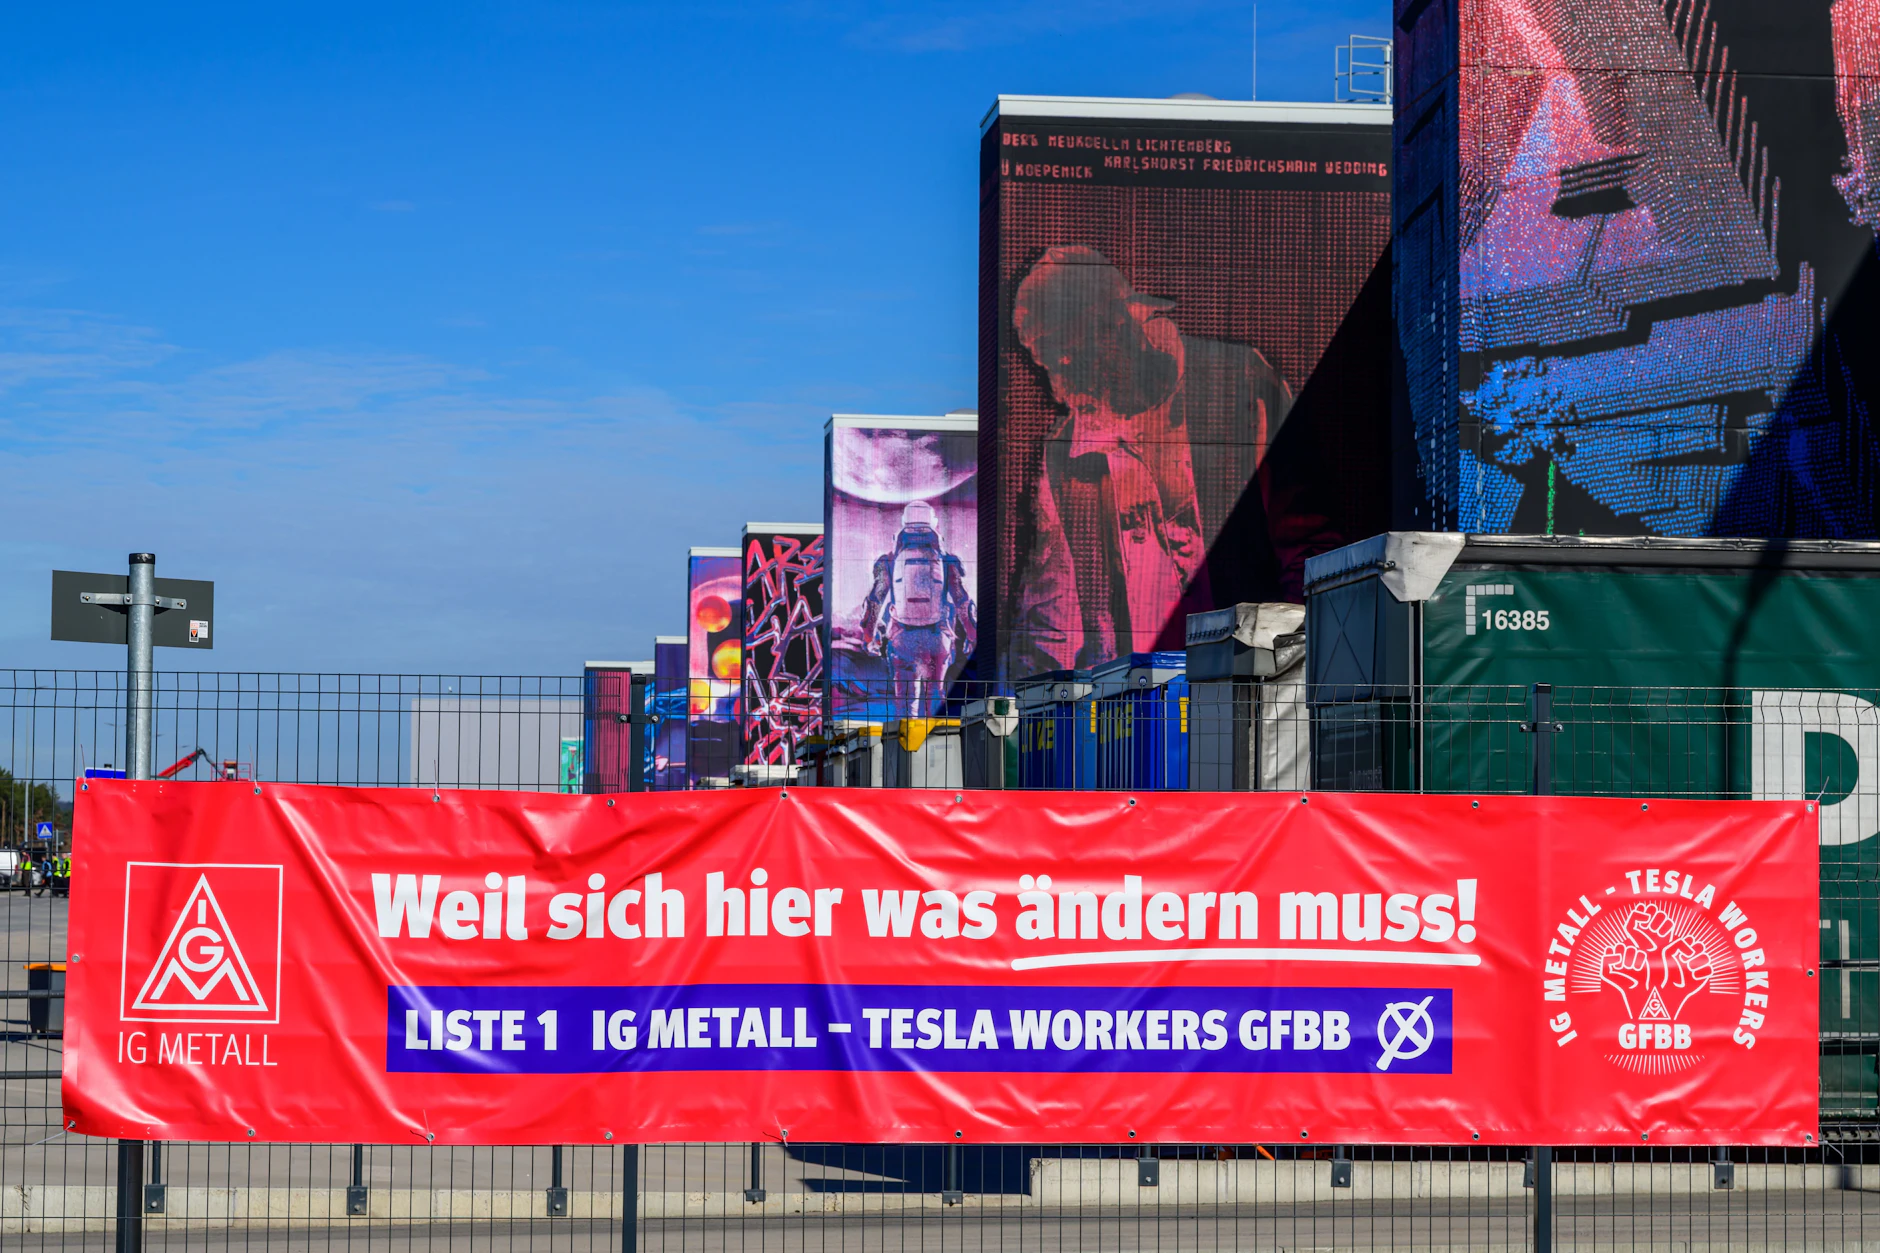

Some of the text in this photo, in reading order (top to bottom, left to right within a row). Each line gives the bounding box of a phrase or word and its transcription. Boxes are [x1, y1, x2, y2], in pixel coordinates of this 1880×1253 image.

[1136, 139, 1232, 154] LICHTENBERG
[1104, 156, 1195, 173] KARLSHORST
[1203, 158, 1317, 174] FRIEDRICHSHAIN
[1325, 161, 1387, 177] WEDDING
[1482, 609, 1550, 631] 16385
[371, 867, 1478, 944] Weil sich hier was ändern muss!
[1625, 868, 1716, 909] TESLA
[1544, 894, 1602, 1002] METALL
[1718, 900, 1770, 1050] WORKERS
[404, 1009, 525, 1051] LISTE
[537, 1010, 558, 1051] 1
[592, 1010, 637, 1051] IG
[647, 1007, 818, 1049] METALL
[862, 1008, 998, 1050] TESLA
[1009, 1009, 1228, 1051] WORKERS
[1238, 1009, 1351, 1051] GFBB
[1549, 1011, 1578, 1047] IG
[1618, 1023, 1692, 1050] GFBB
[118, 1031, 278, 1066] IG METALL
